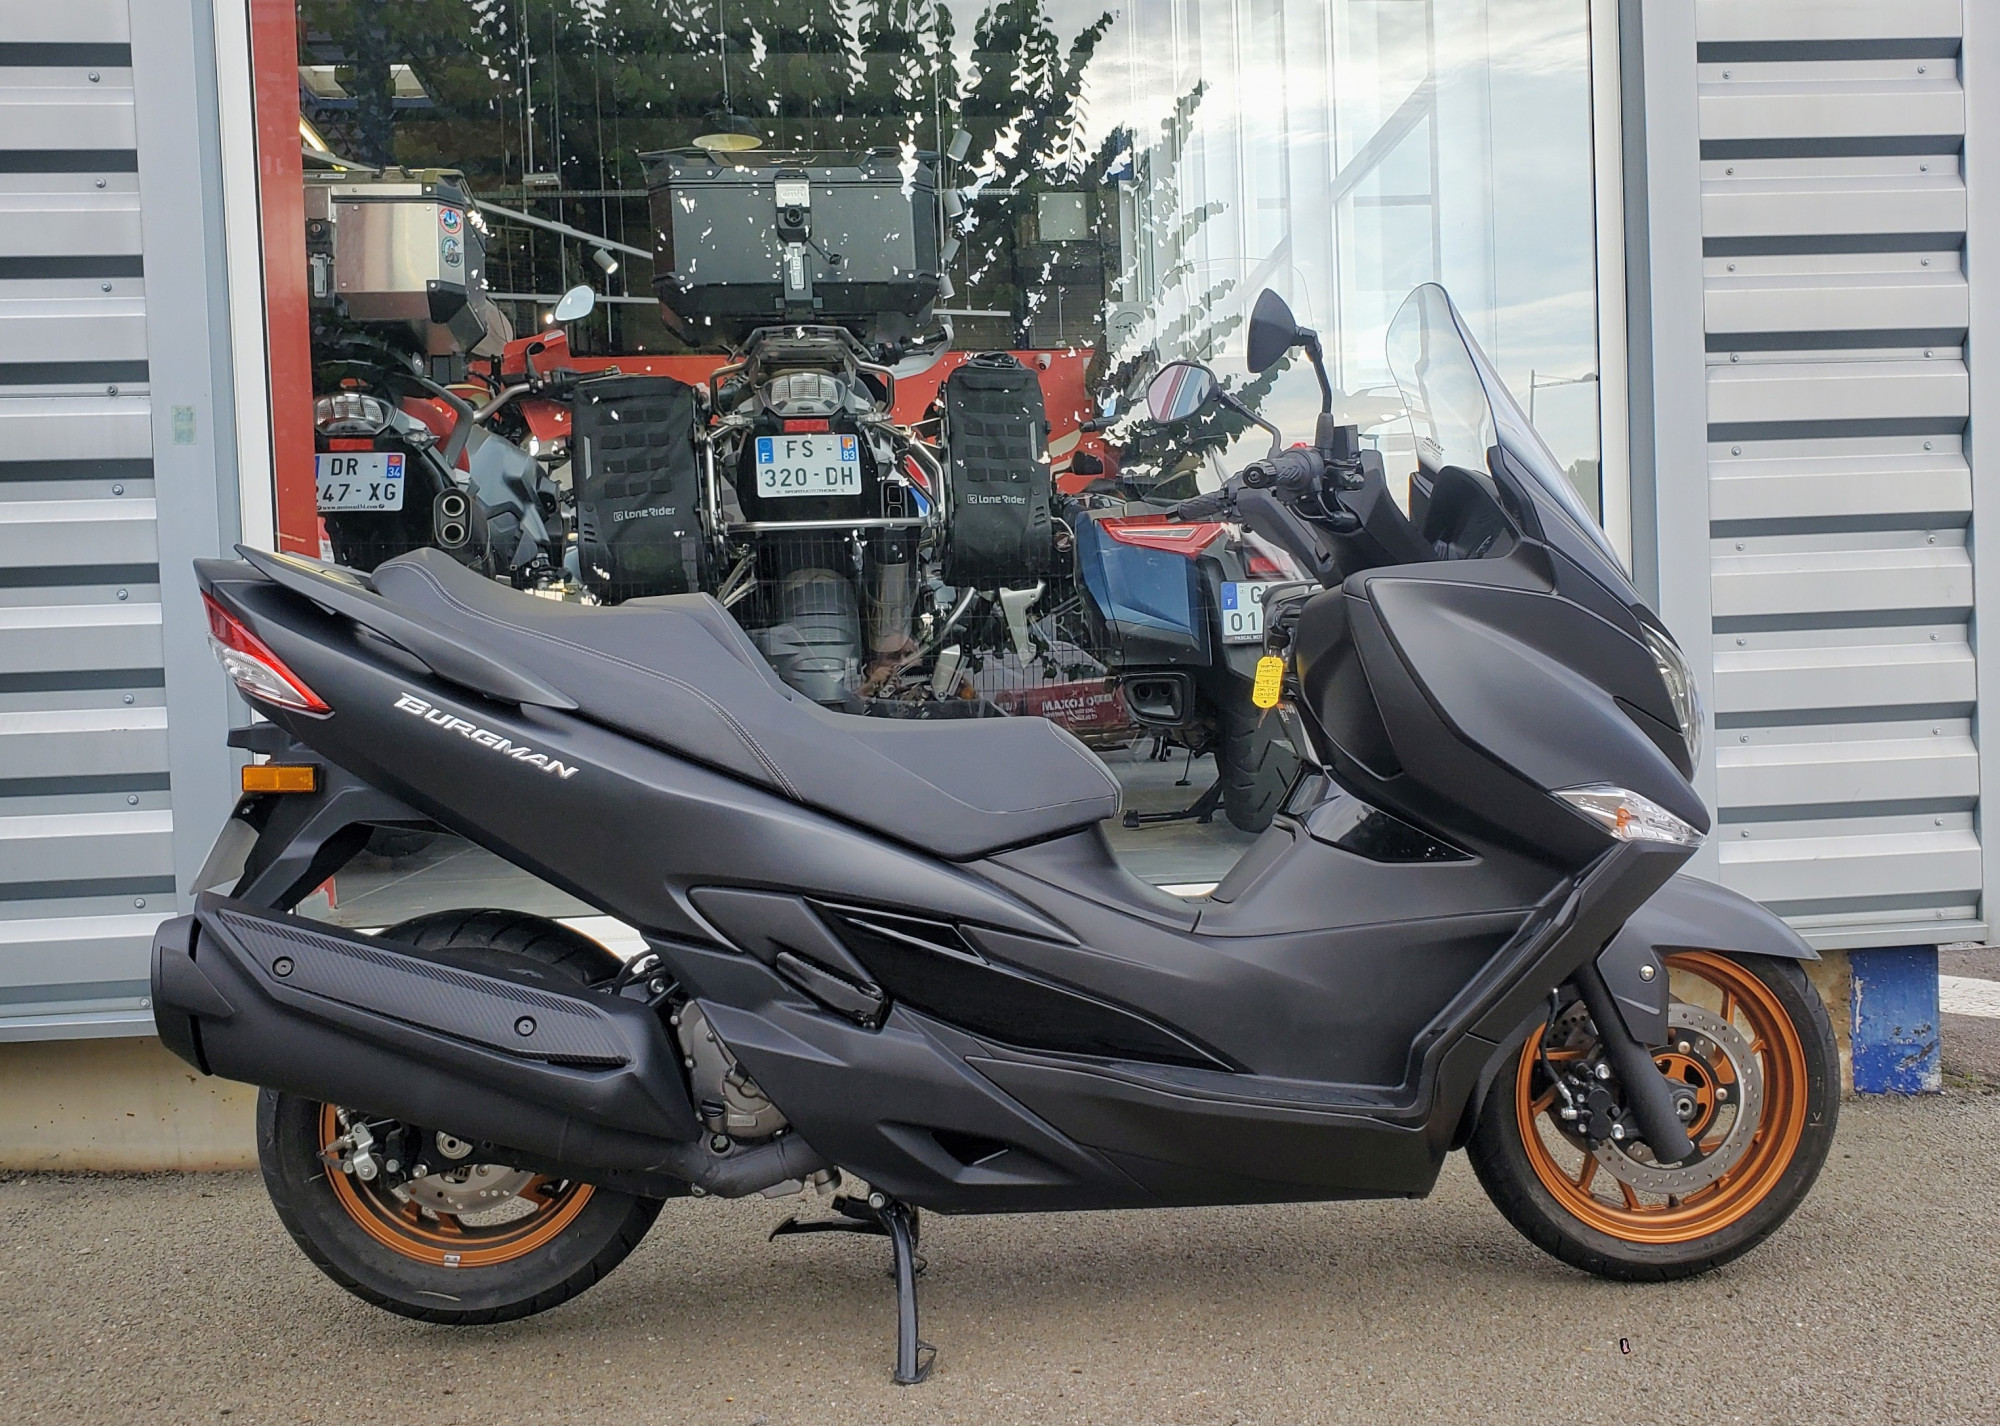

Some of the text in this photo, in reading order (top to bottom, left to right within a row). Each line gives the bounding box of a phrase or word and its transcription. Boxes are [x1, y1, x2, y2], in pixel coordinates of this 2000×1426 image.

[786, 440, 813, 459] FS
[761, 453, 770, 463] F
[843, 450, 855, 460] 83
[331, 458, 358, 476] DR
[387, 467, 401, 477] 34
[1227, 598, 1234, 606] F
[393, 691, 580, 779] BURGMAN
